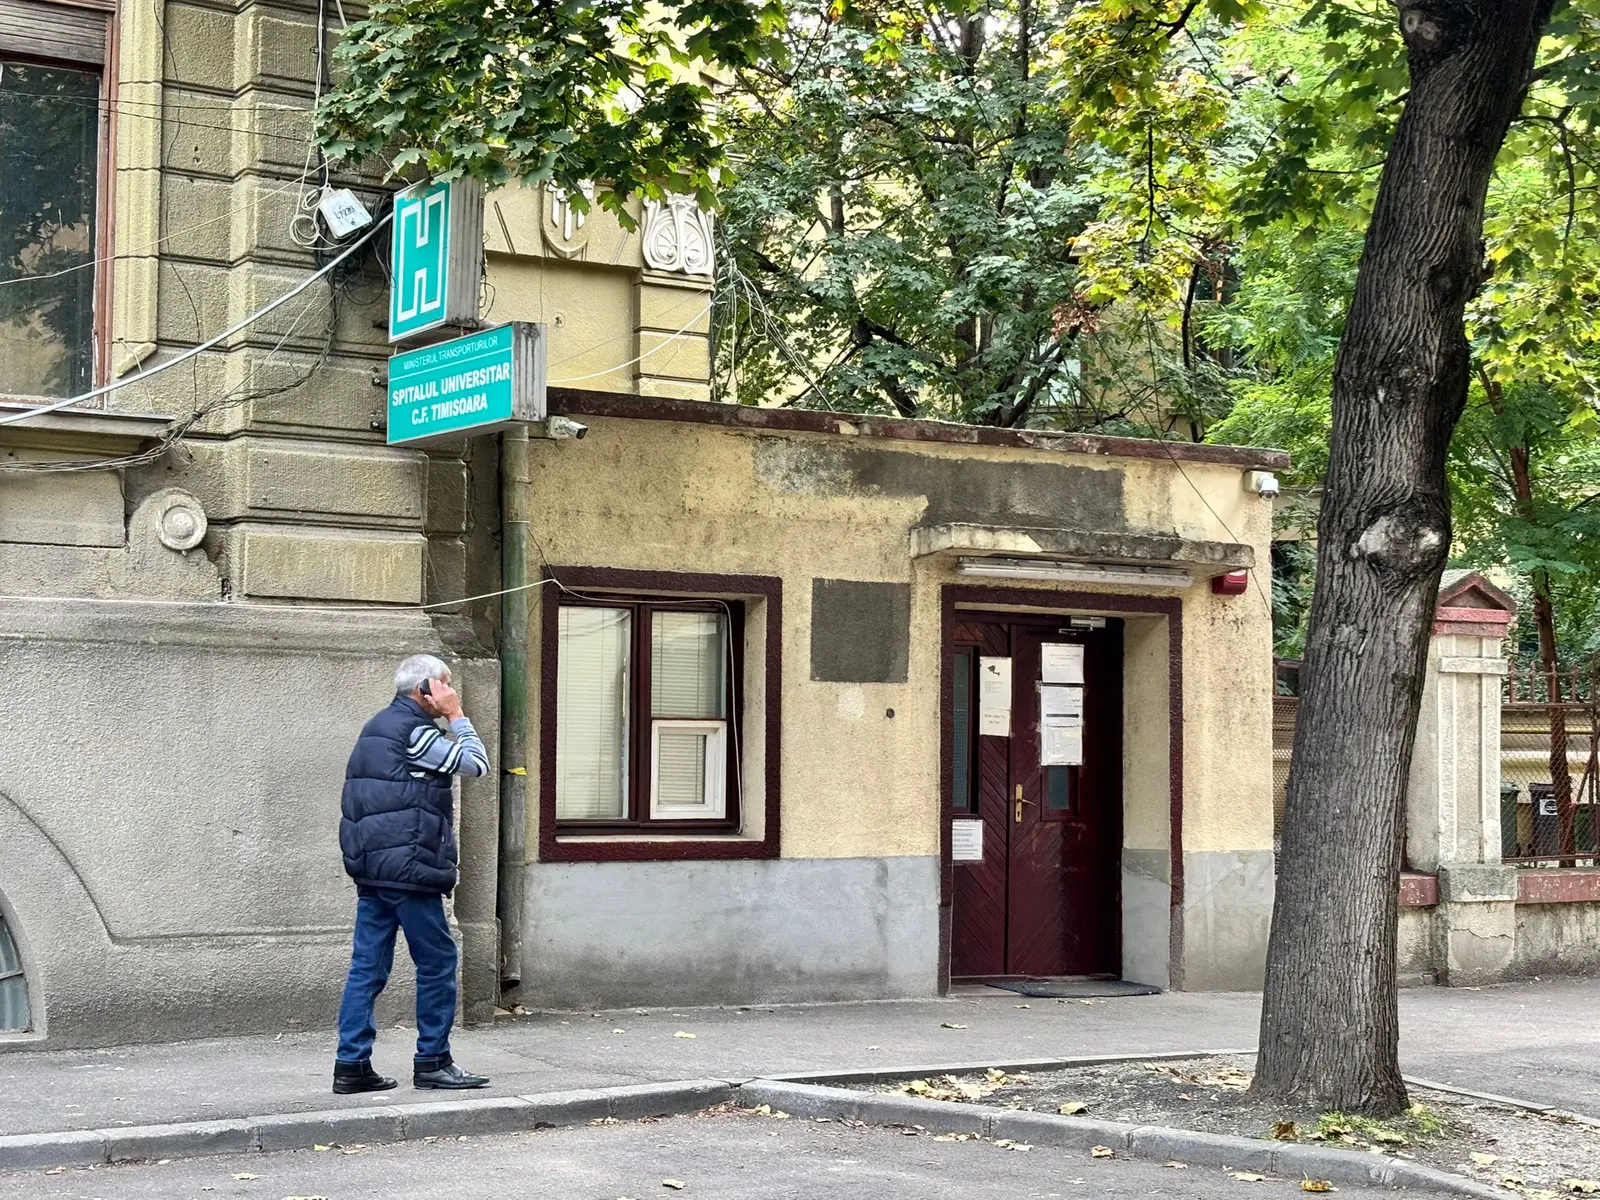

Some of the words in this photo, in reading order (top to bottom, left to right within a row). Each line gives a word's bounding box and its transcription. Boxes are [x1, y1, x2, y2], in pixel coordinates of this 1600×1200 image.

[397, 190, 445, 322] H
[403, 354, 438, 370] MINISTERUL
[438, 336, 498, 360] TRANSPORTURILOR
[392, 381, 439, 406] SPITALUL
[441, 362, 510, 395] UNIVERSITAR
[411, 406, 428, 425] C.F.
[431, 393, 488, 420] TIMISOARA
